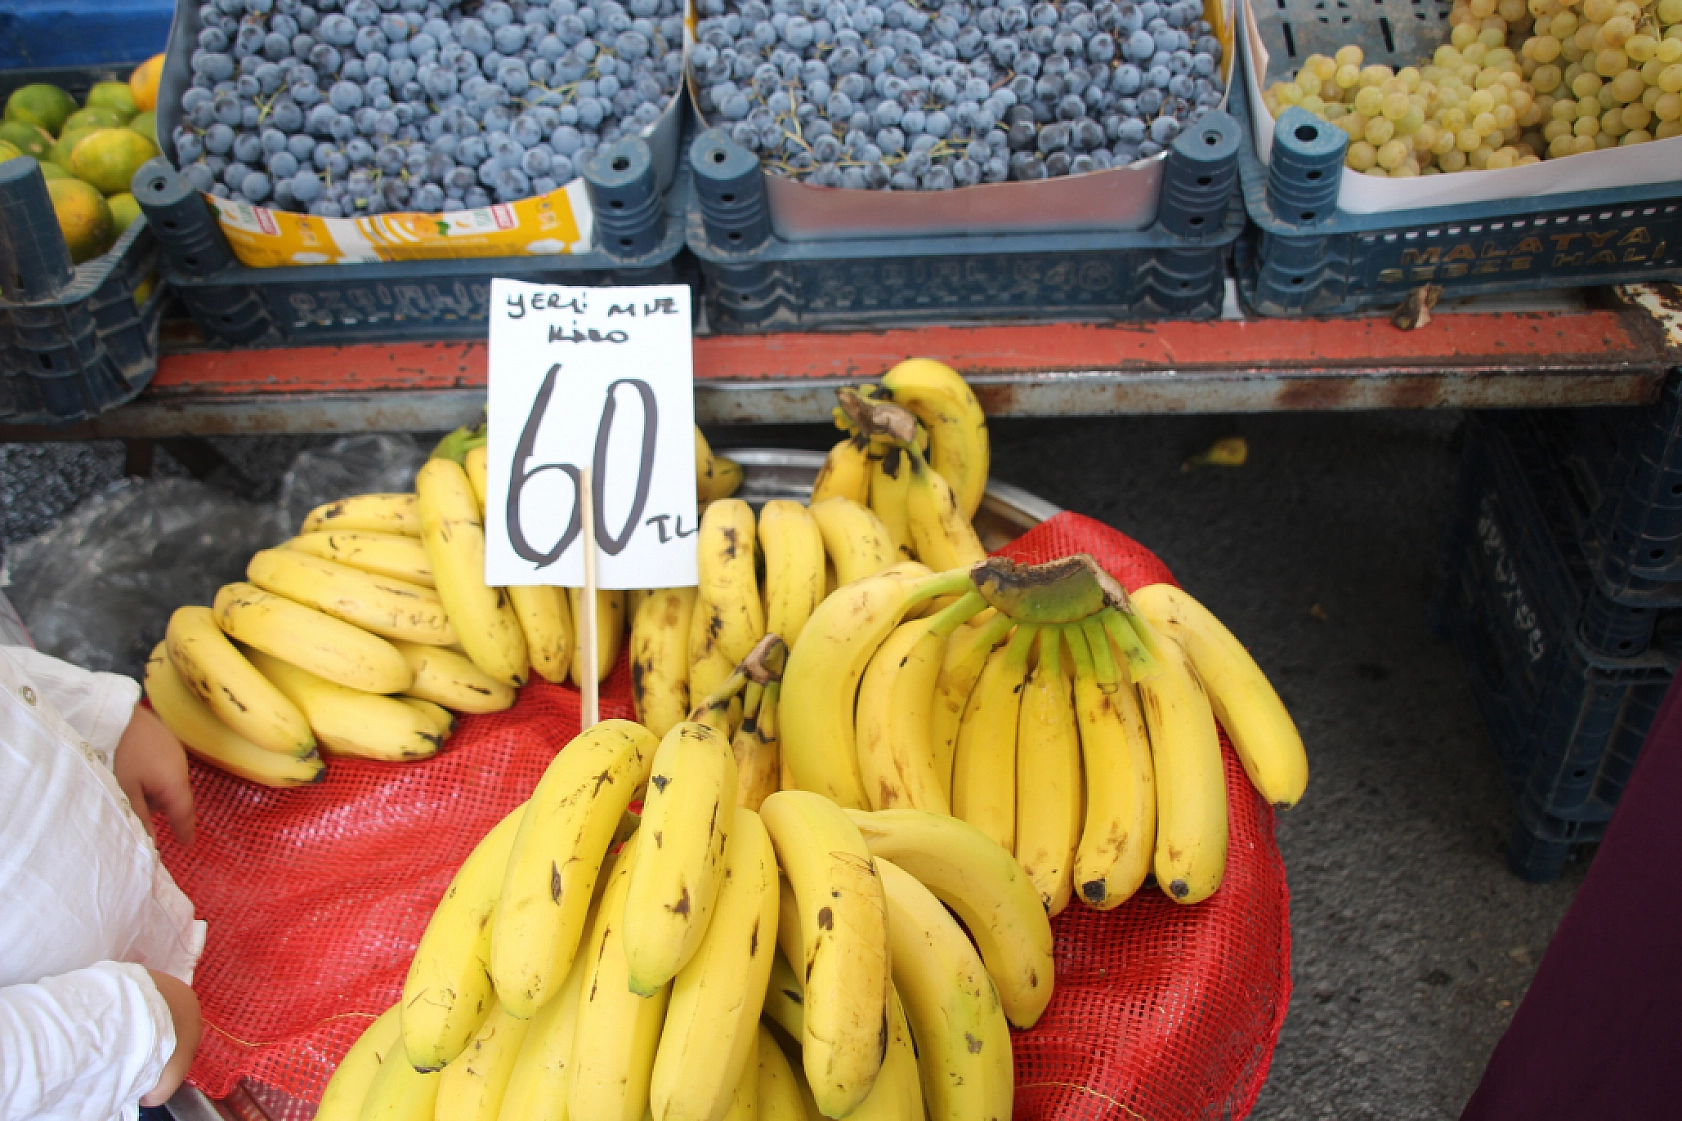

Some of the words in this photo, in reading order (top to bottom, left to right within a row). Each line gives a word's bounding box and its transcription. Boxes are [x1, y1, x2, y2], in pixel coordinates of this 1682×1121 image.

[1401, 226, 1651, 264] MALATYA
[506, 363, 657, 570] 60
[646, 514, 698, 544] TL
